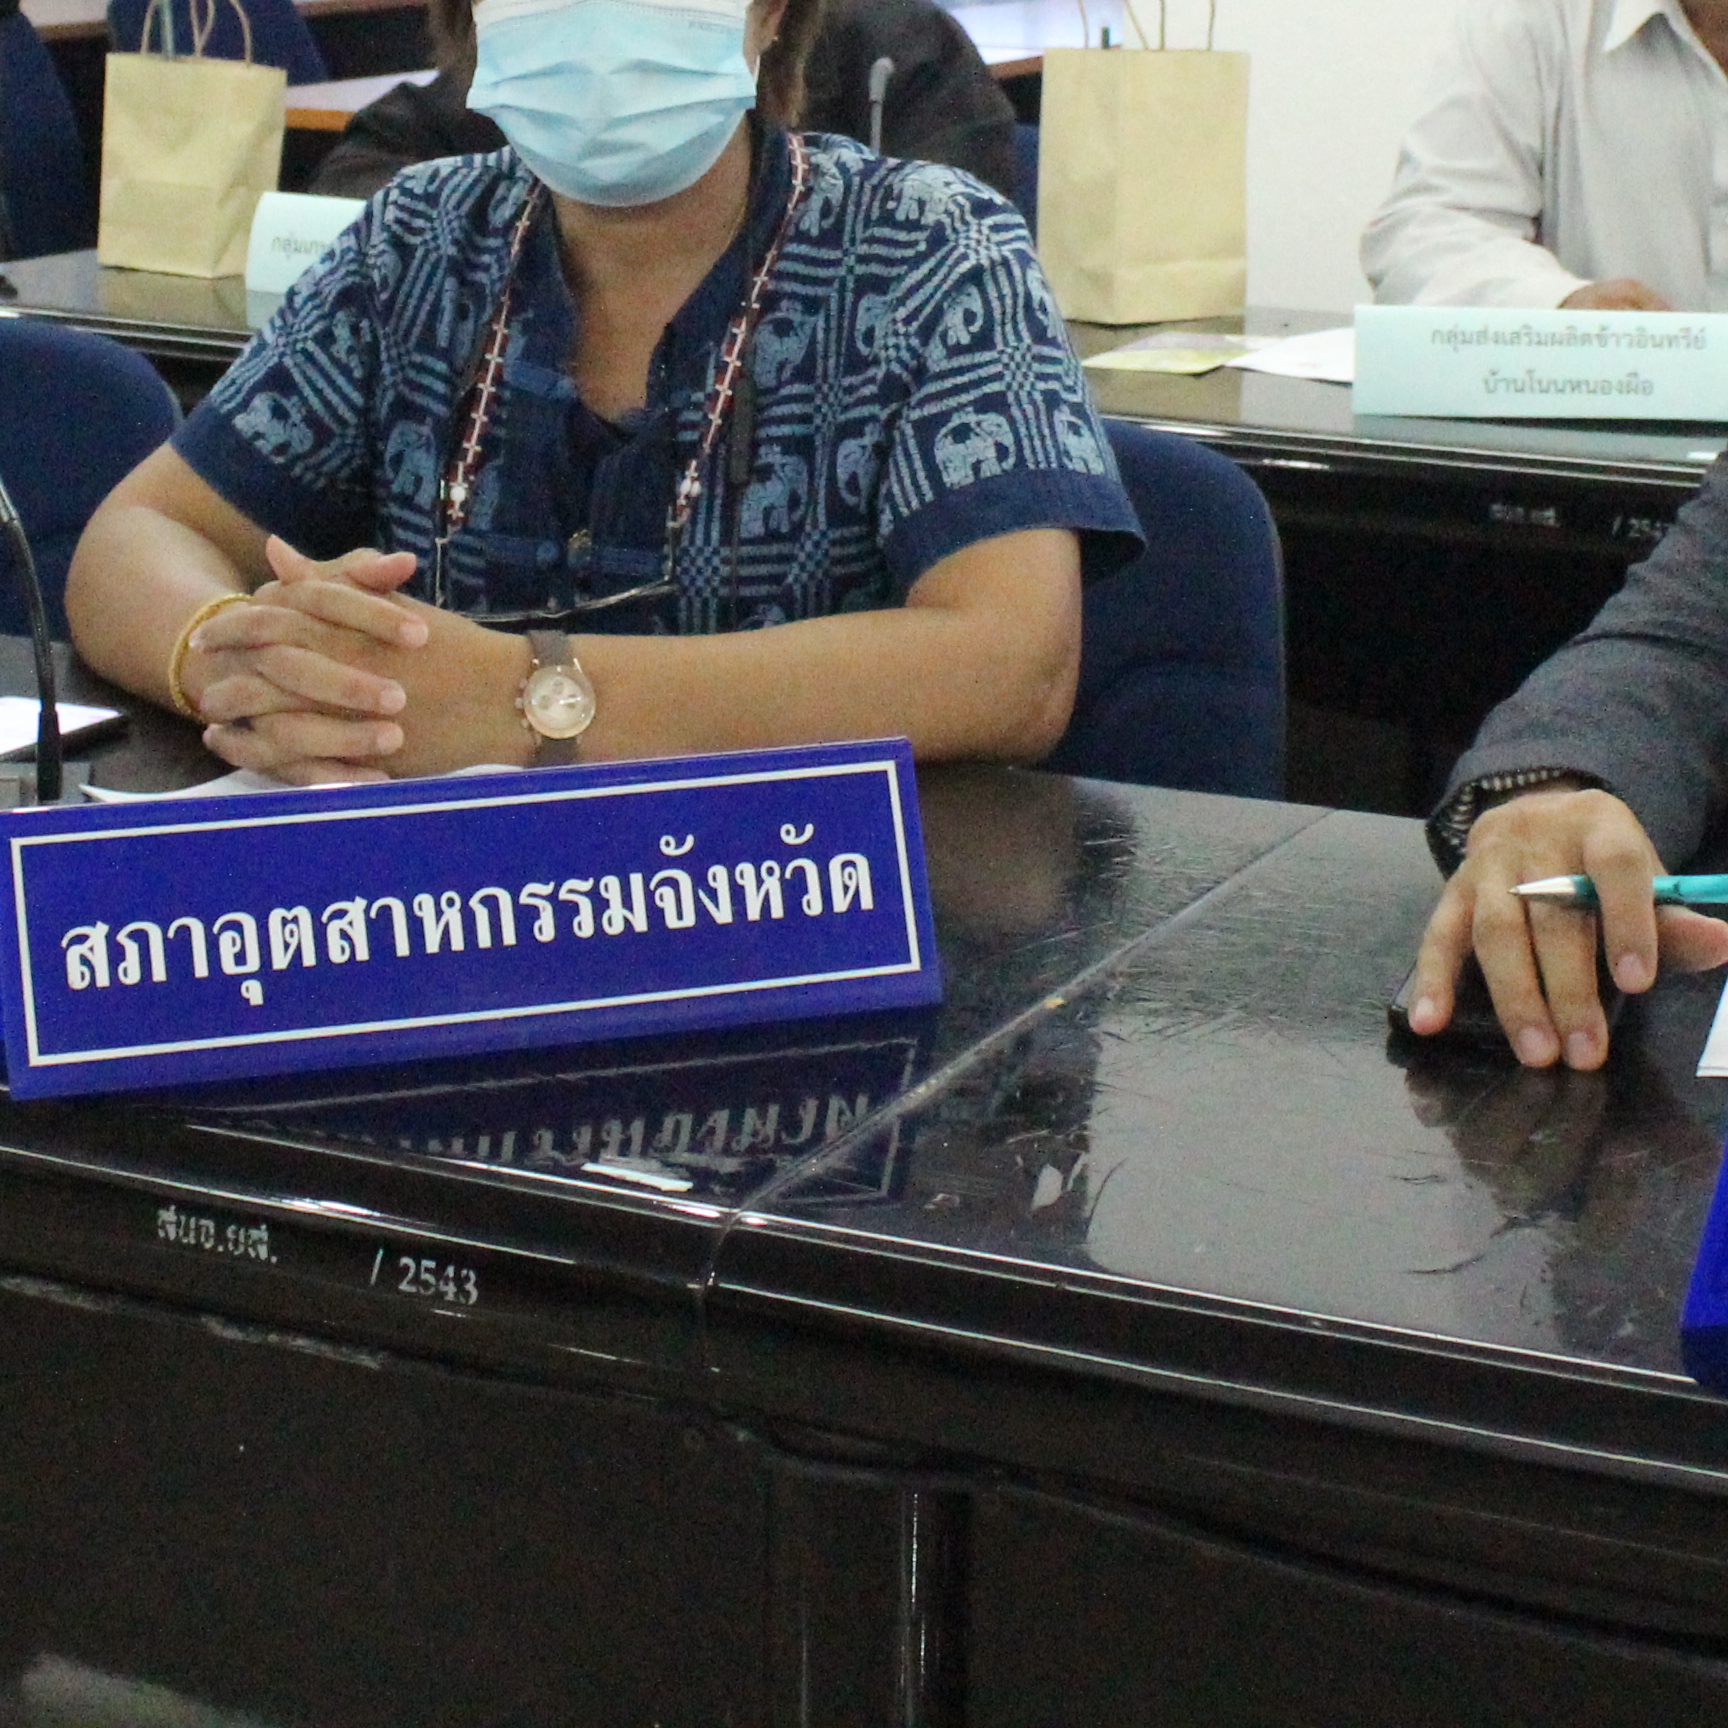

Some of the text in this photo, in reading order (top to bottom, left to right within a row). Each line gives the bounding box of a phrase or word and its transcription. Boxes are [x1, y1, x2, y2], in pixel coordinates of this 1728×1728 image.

[60, 822, 876, 1008] สภาอุตสาหกรรมจังหวัด
[398, 1256, 479, 1306] 2543
